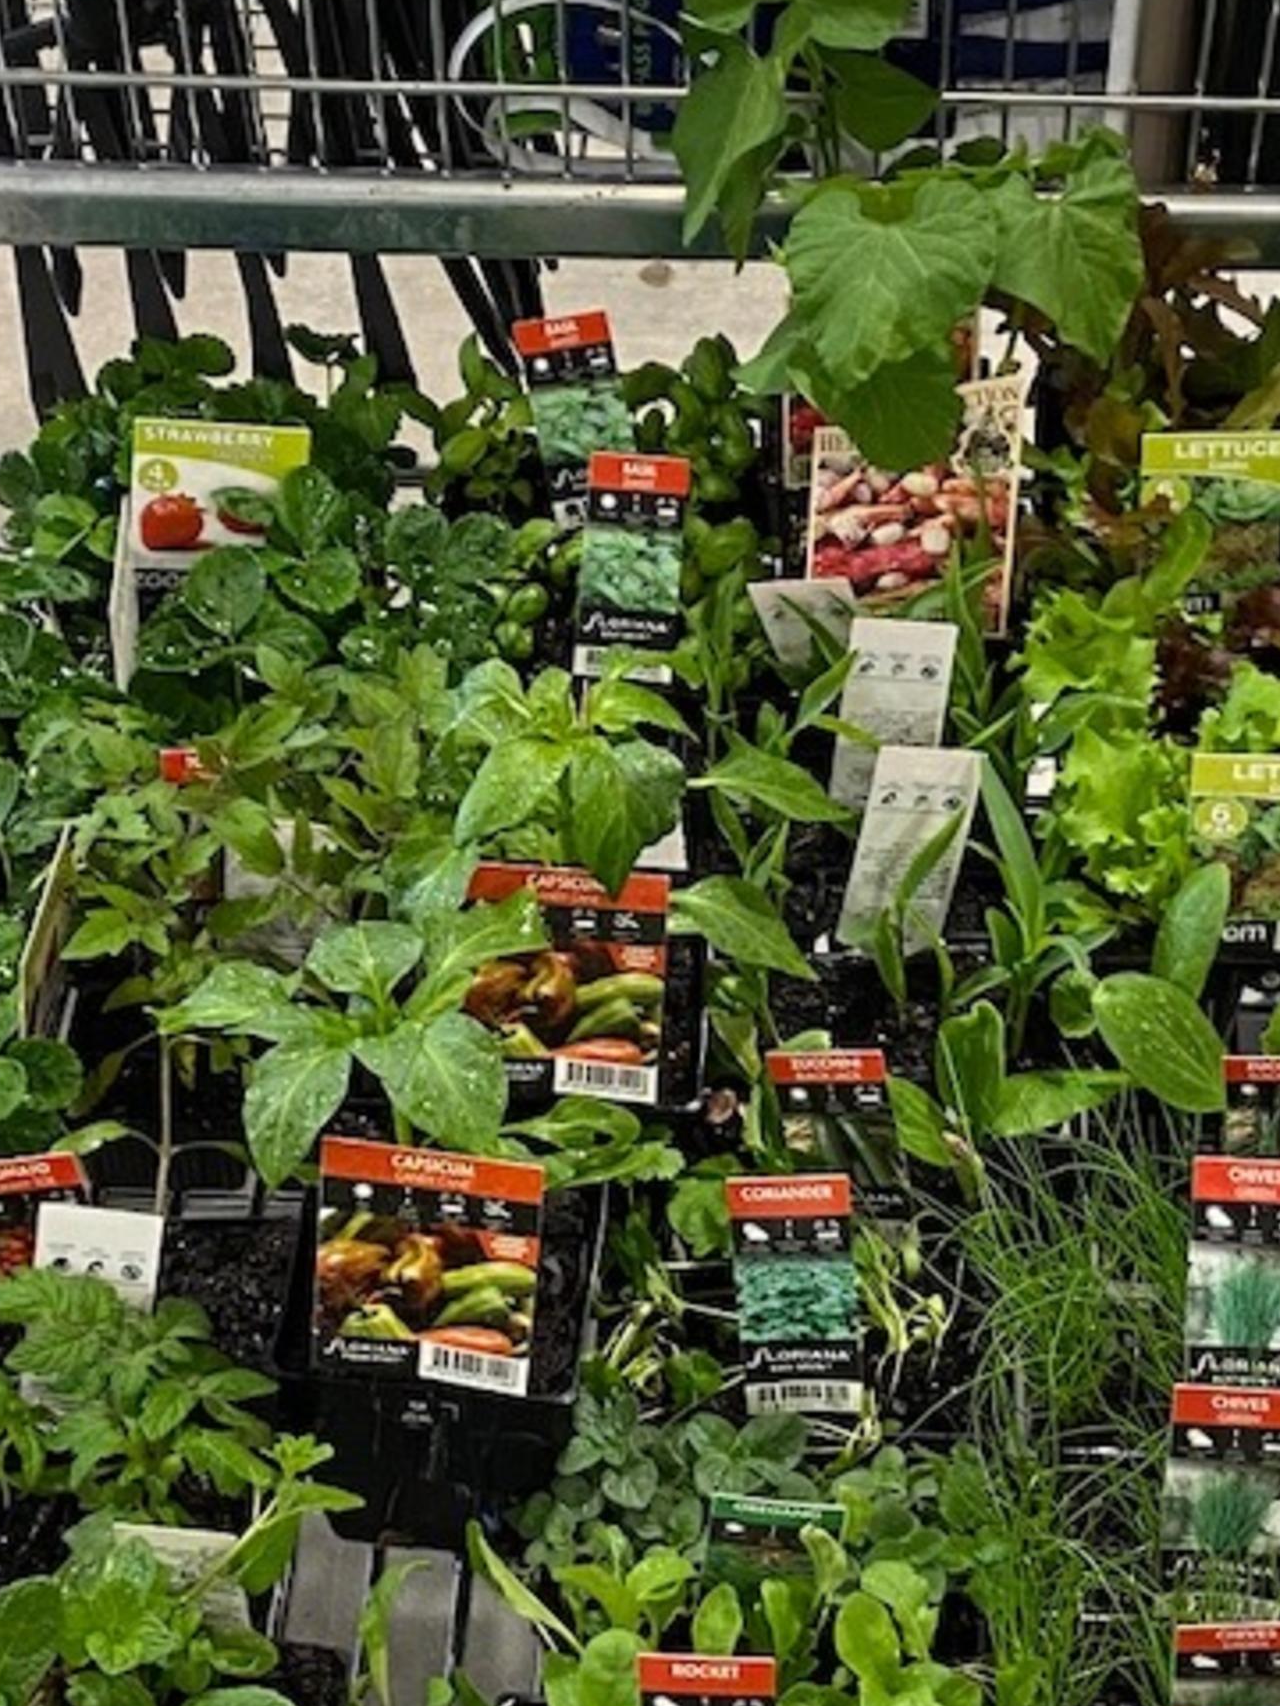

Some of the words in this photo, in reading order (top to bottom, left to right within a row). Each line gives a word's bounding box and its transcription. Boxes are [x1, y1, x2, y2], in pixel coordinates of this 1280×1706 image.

[144, 426, 275, 448] STRAWBERRY
[390, 1153, 476, 1178] CAPSICUM
[739, 1185, 833, 1202] CORIANDER
[1210, 1394, 1271, 1412] CHIVES
[670, 1662, 741, 1680] ROCKET
